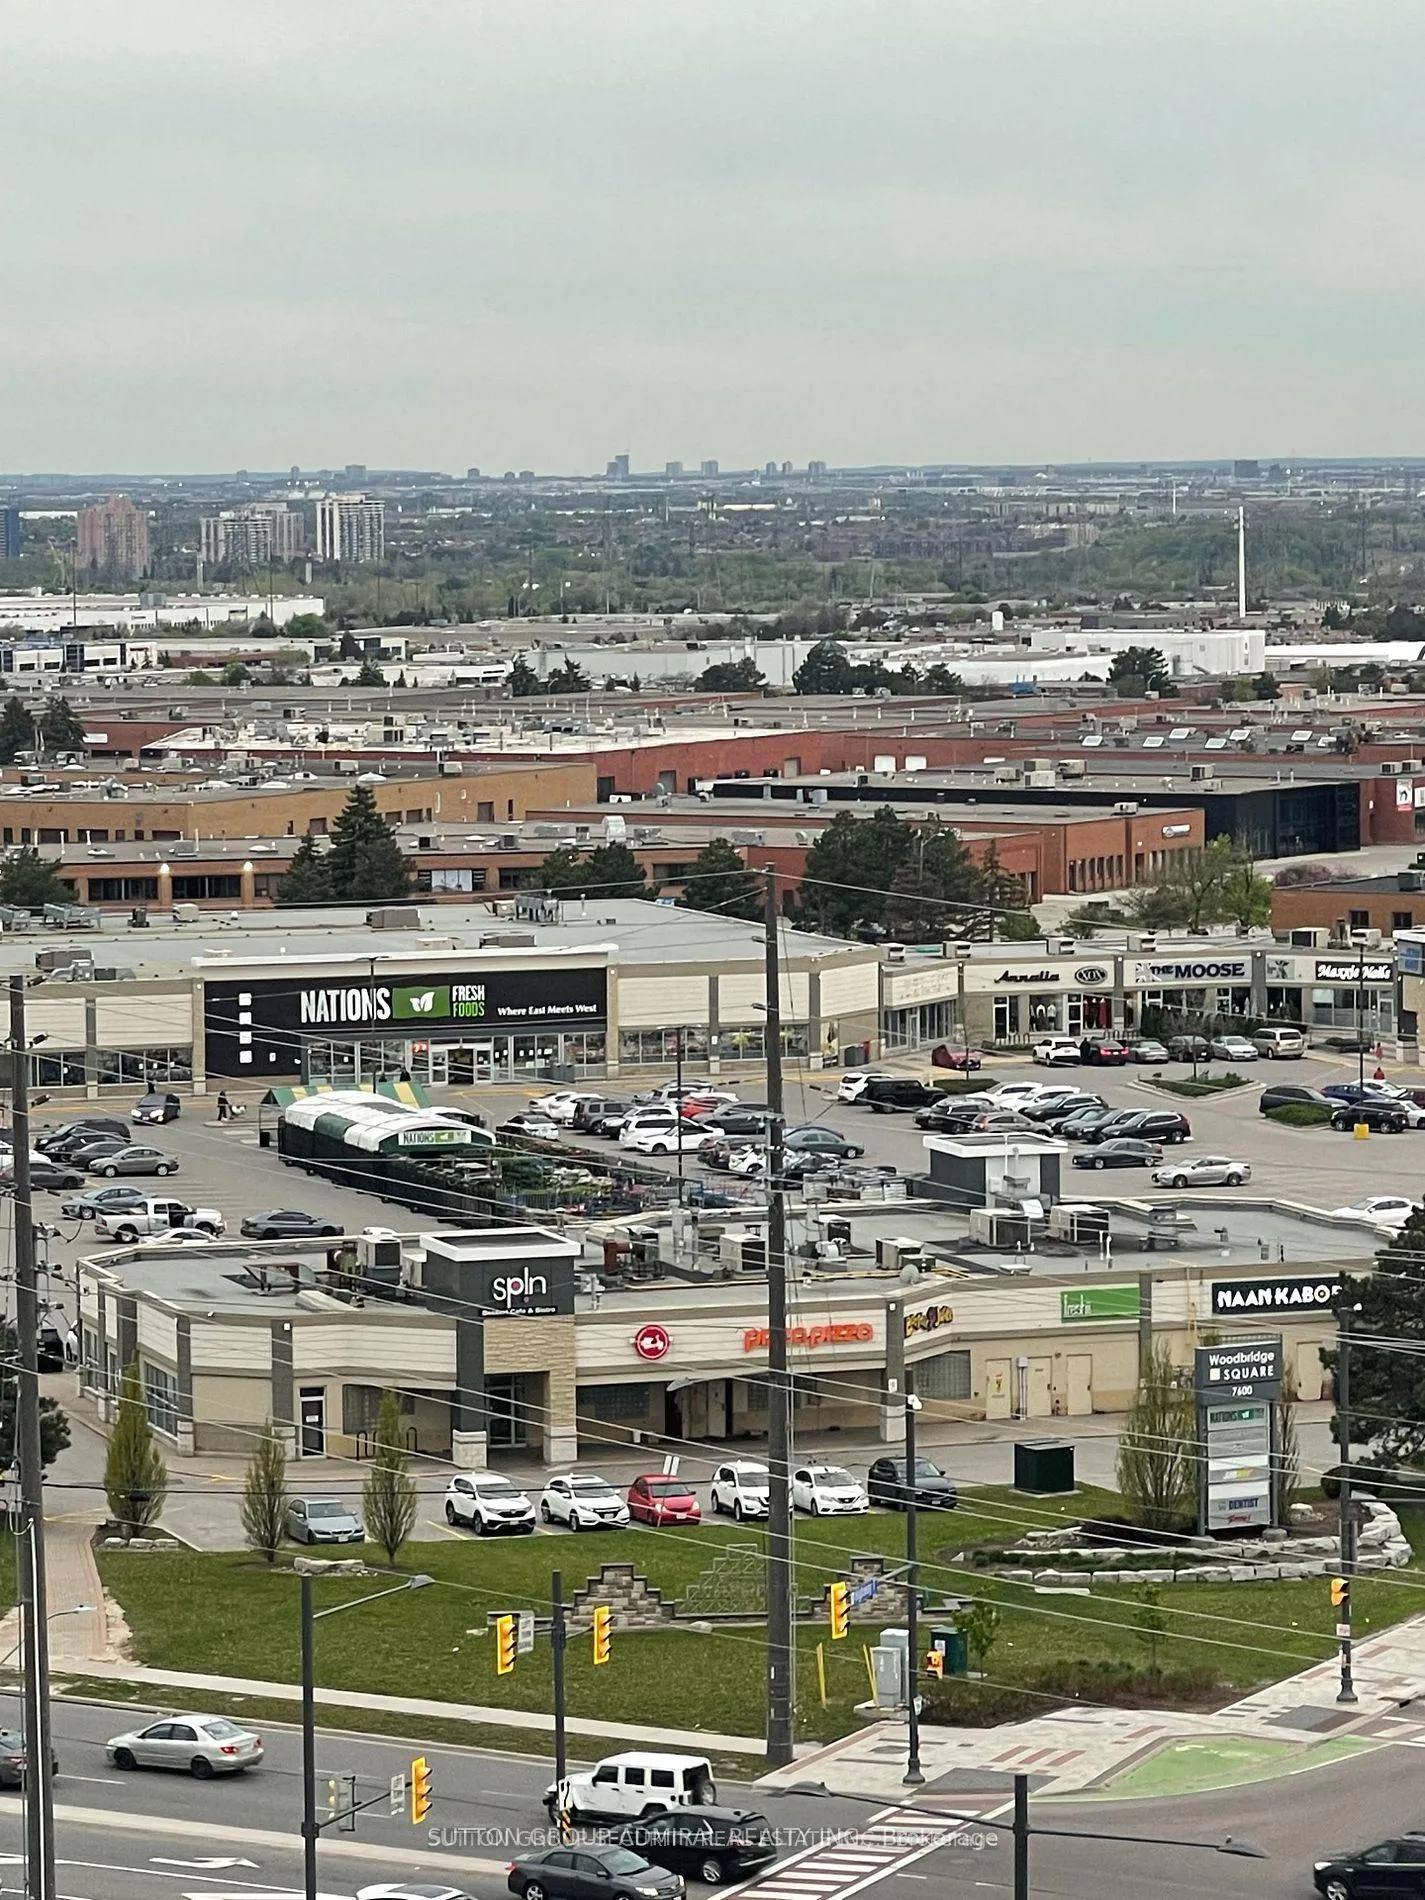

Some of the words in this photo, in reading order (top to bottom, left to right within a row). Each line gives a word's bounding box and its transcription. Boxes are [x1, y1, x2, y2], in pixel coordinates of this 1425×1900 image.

[1174, 963, 1245, 979] MOOSE
[452, 985, 486, 1002] FRESH
[301, 987, 391, 1024] NATIONS
[453, 1001, 486, 1018] FOODS
[497, 1006, 526, 1016] Where
[528, 1006, 546, 1015] East
[547, 1004, 574, 1014] Meets
[575, 1004, 597, 1013] West
[403, 1131, 434, 1145] NATIONS
[1217, 1287, 1273, 1308] NAAN
[1209, 1351, 1275, 1366] Woodbridge
[1223, 1365, 1274, 1380] SQUARE
[1232, 1385, 1253, 1397] 7600
